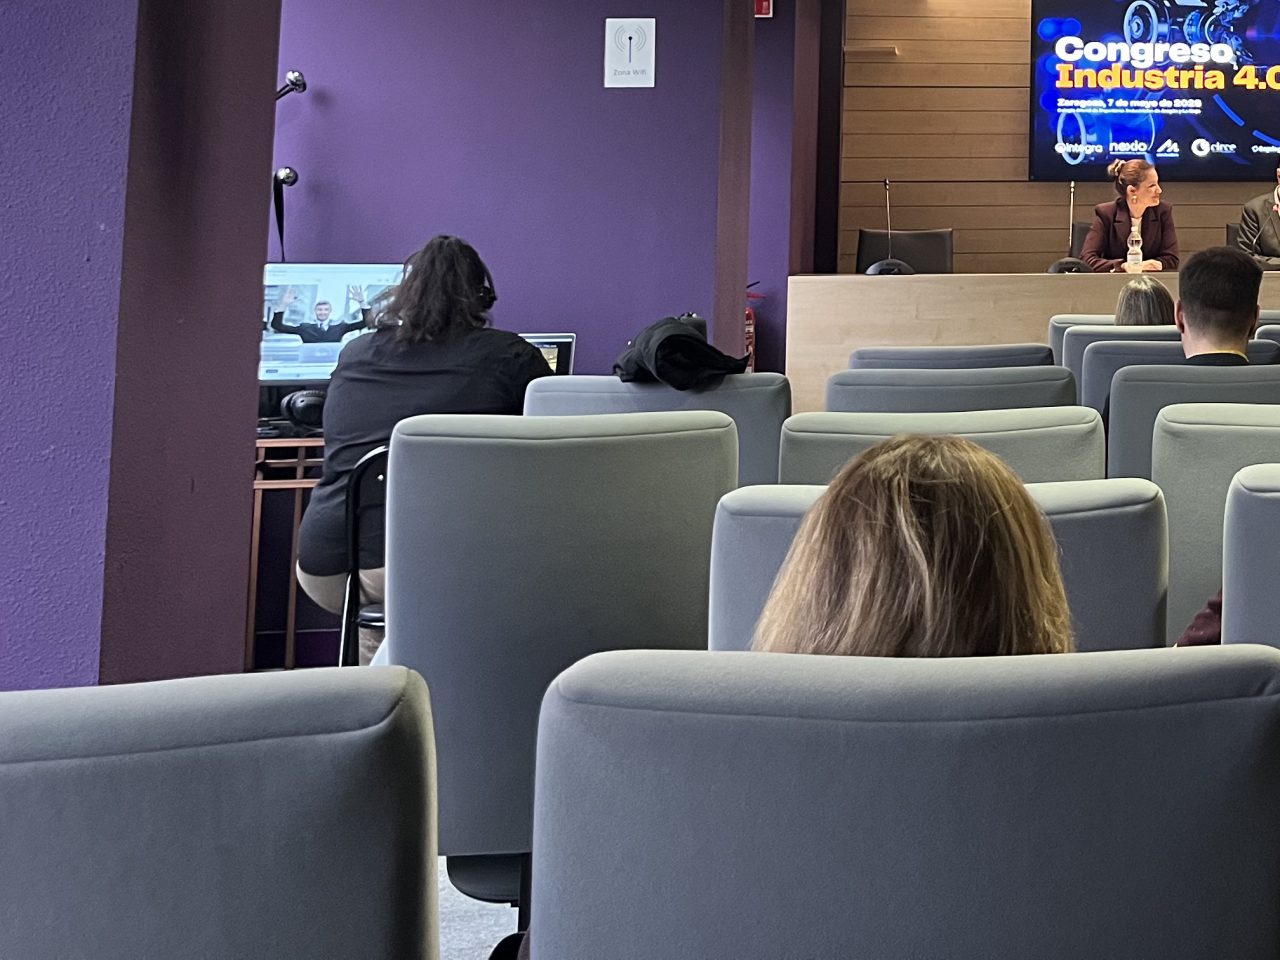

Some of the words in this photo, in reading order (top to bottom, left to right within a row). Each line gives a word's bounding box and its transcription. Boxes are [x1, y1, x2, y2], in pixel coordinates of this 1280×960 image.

[1055, 36, 1234, 68] Congreso
[1055, 63, 1225, 90] Industria
[1107, 98, 1114, 107] 7
[1115, 98, 1129, 108] de
[1129, 100, 1158, 109] mayo
